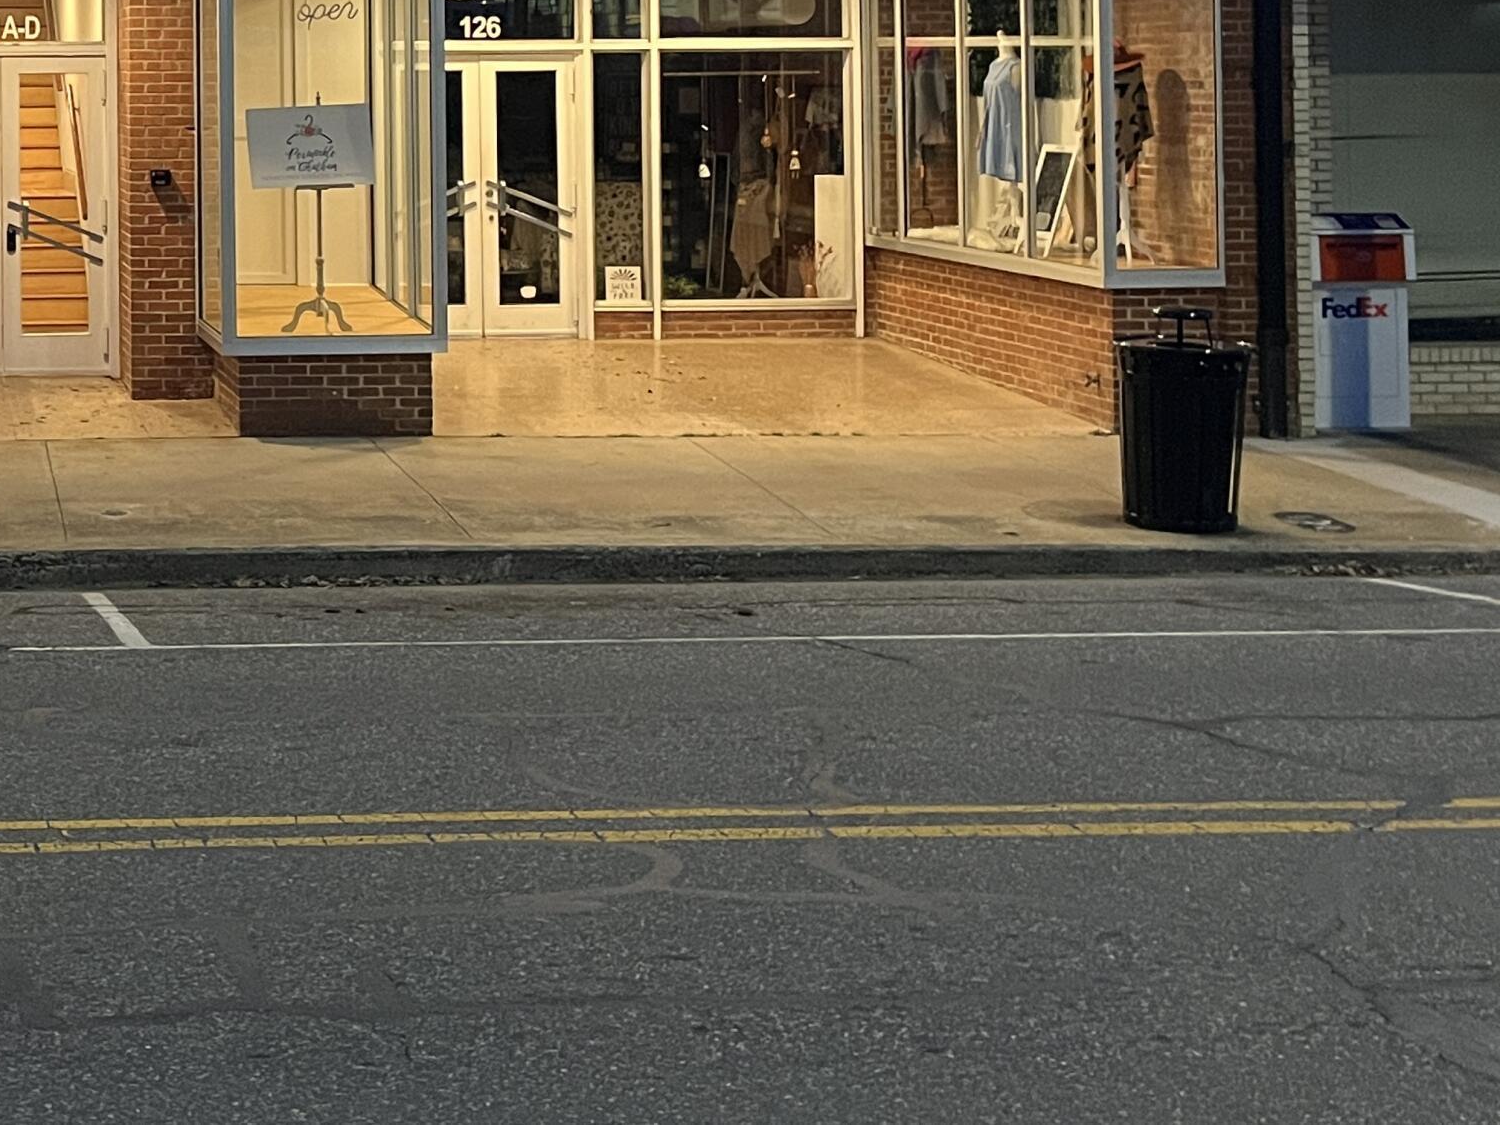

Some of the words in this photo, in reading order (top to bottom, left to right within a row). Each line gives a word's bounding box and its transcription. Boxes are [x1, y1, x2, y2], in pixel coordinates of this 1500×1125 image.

[297, 1, 359, 31] open
[459, 15, 501, 38] 126
[1321, 296, 1388, 319] FedEx
